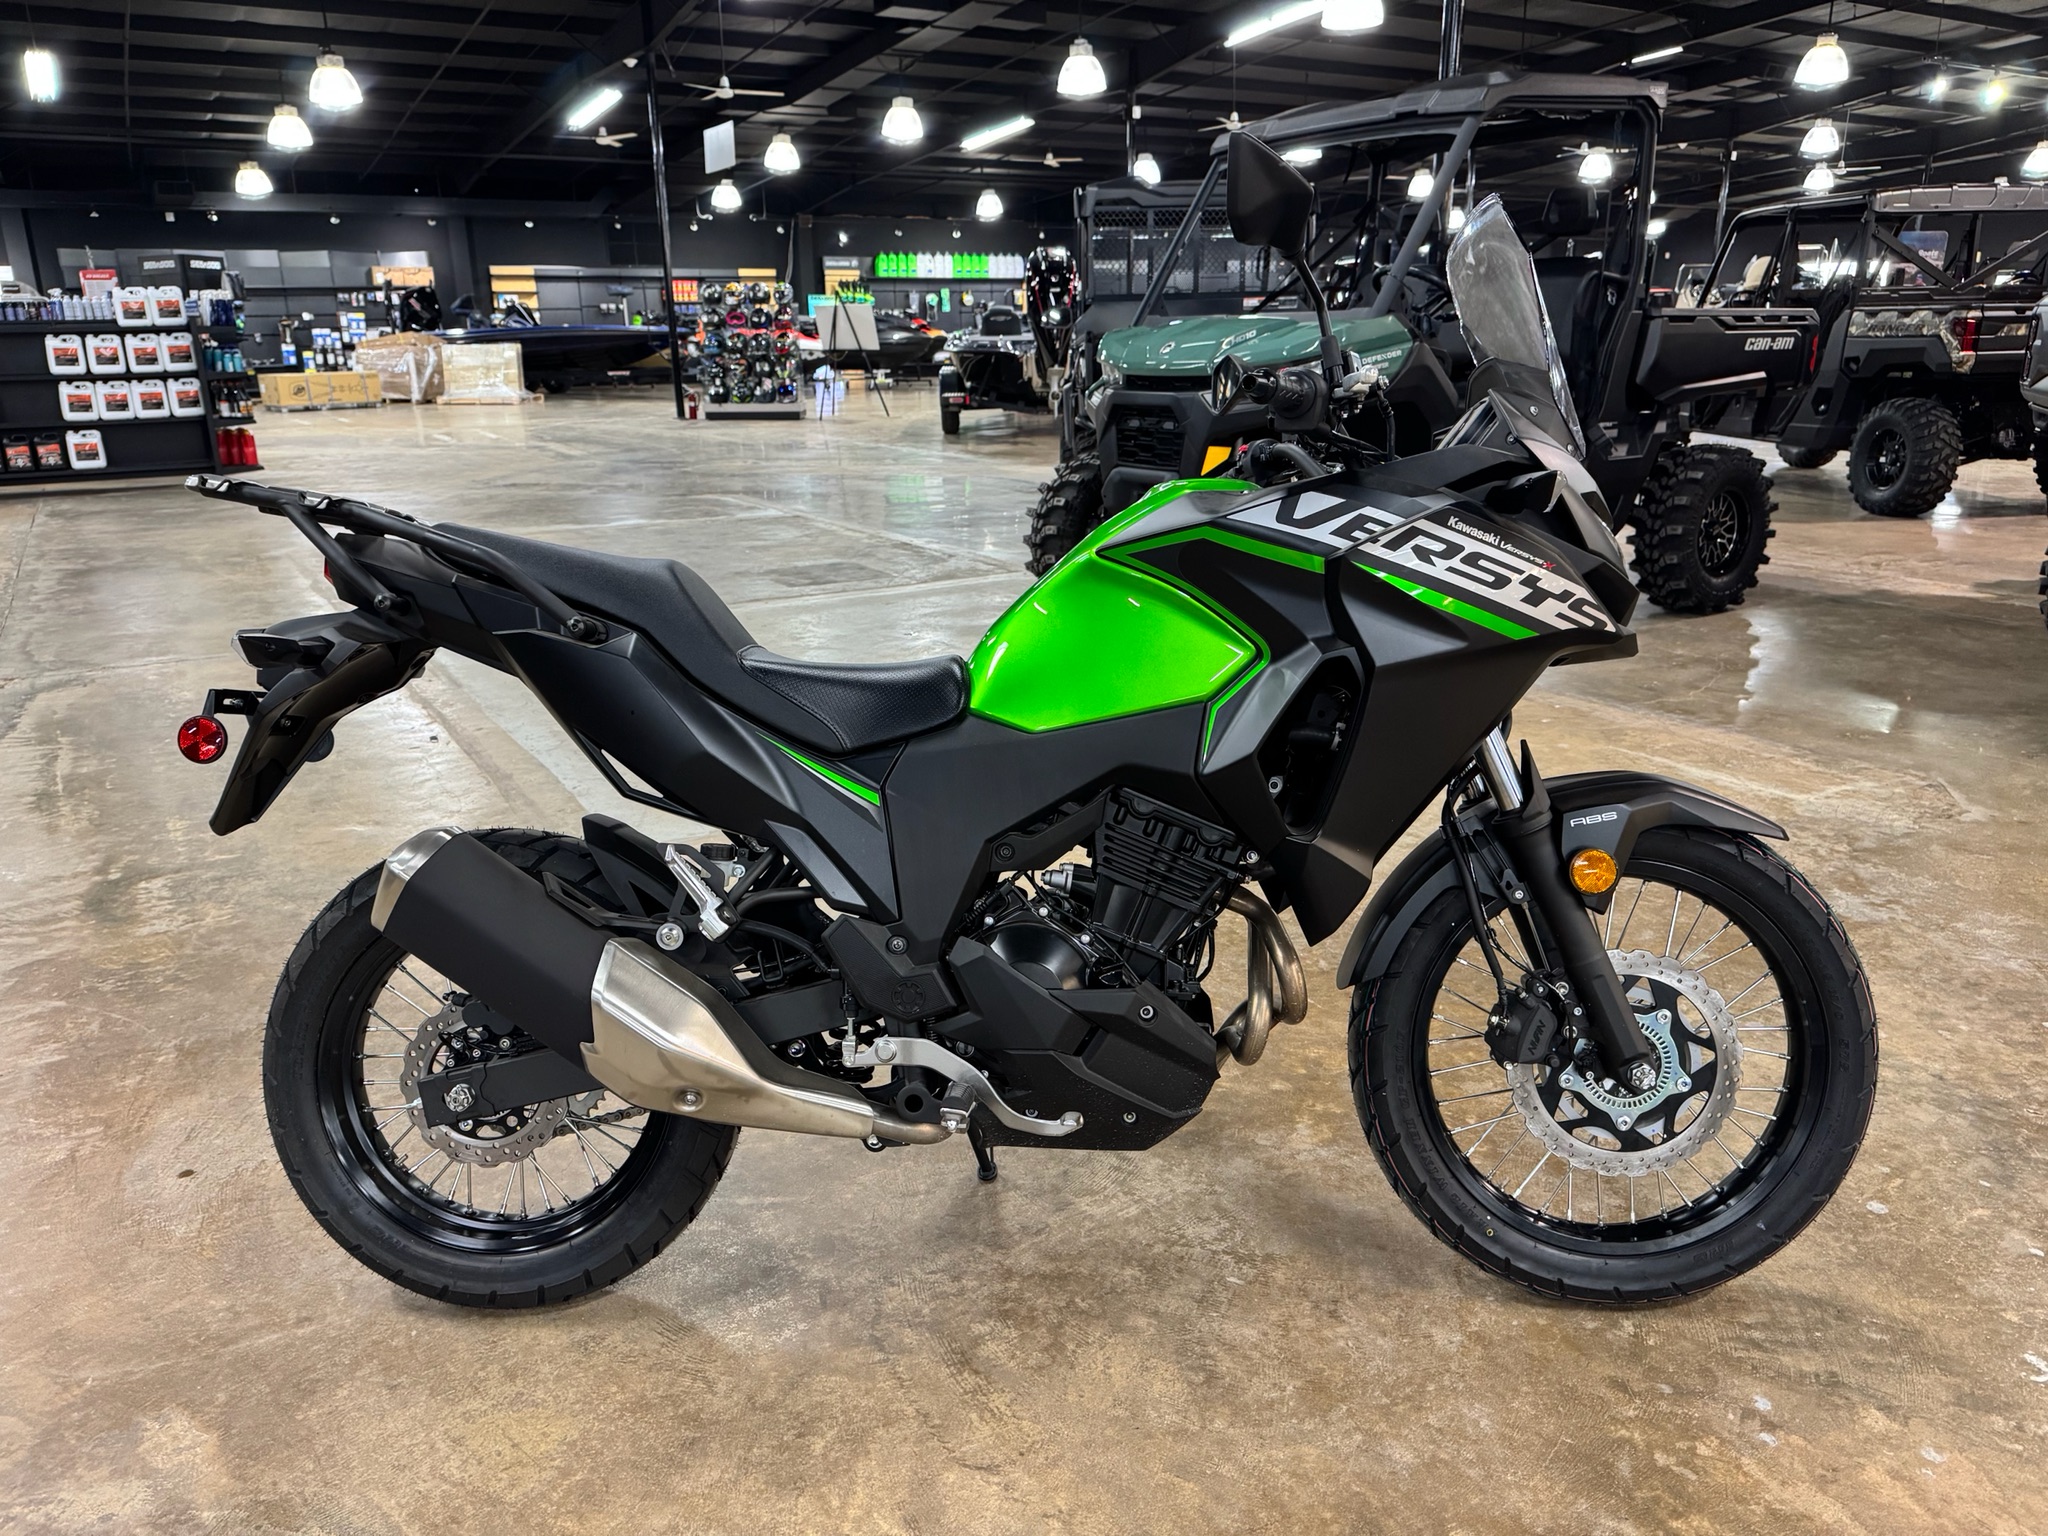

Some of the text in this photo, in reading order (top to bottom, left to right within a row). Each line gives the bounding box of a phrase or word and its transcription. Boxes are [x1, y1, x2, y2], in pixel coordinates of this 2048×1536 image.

[1867, 322, 1926, 334] RANGER
[1447, 515, 1501, 546] Kawasaki
[1276, 492, 1608, 633] VERSYS
[1570, 811, 1618, 828] ABS
